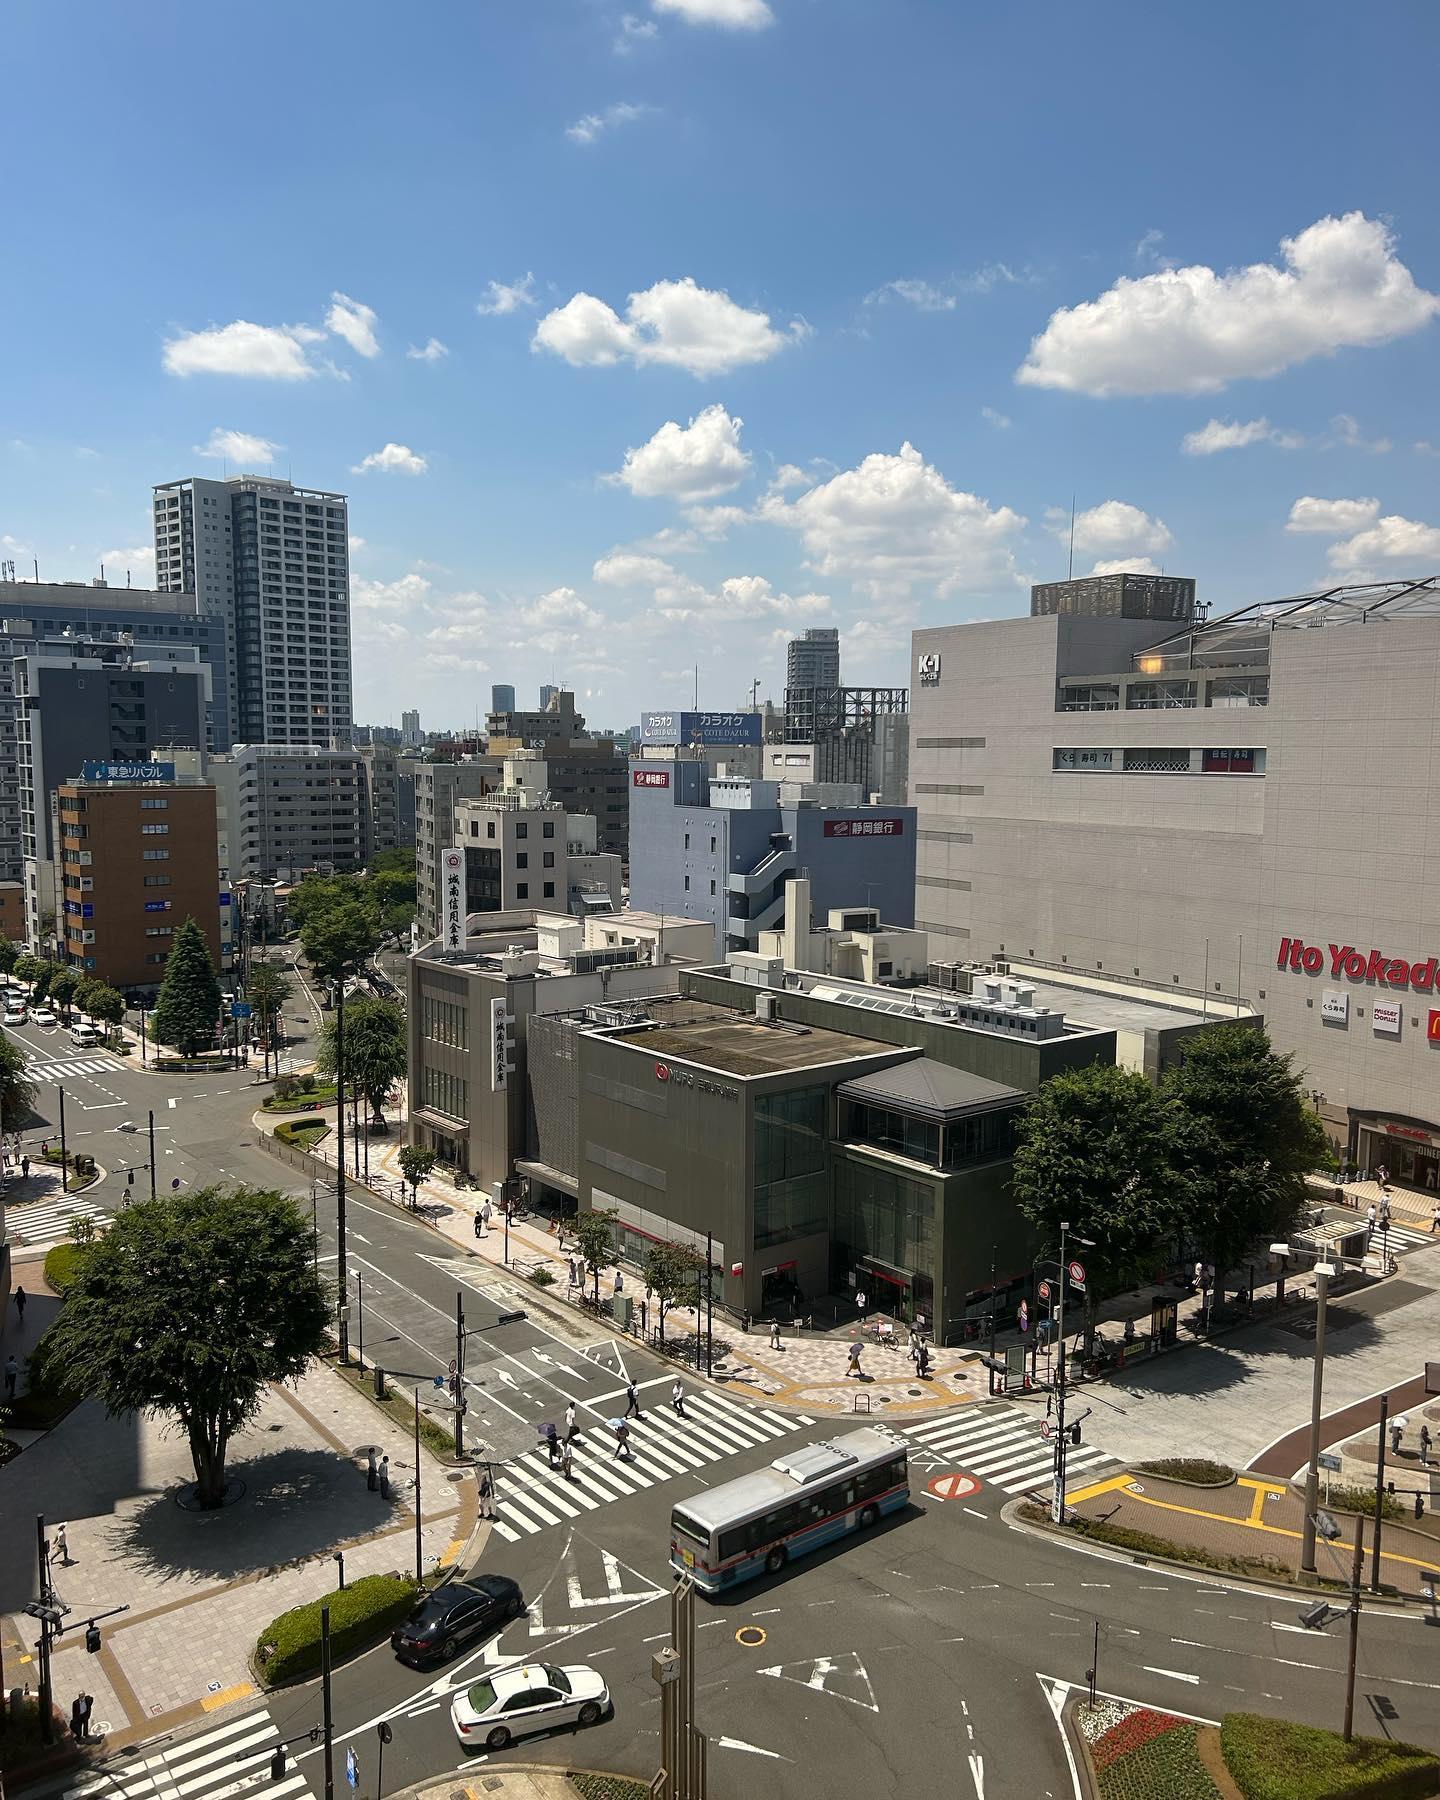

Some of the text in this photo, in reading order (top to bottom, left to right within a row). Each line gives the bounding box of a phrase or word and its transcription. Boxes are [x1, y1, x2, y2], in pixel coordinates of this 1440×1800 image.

[919, 654, 940, 672] K-1
[648, 716, 673, 727] カラオケ
[700, 715, 744, 726] カラオケ
[530, 739, 546, 748] K-3
[107, 766, 163, 778] 東急リバブル
[852, 821, 895, 835] 静岡銀行
[448, 873, 462, 949] 城南信用金庫
[1277, 937, 1323, 971] Ito
[1323, 1003, 1345, 1013] くら寿司
[495, 1022, 506, 1084] 城南信用金庫
